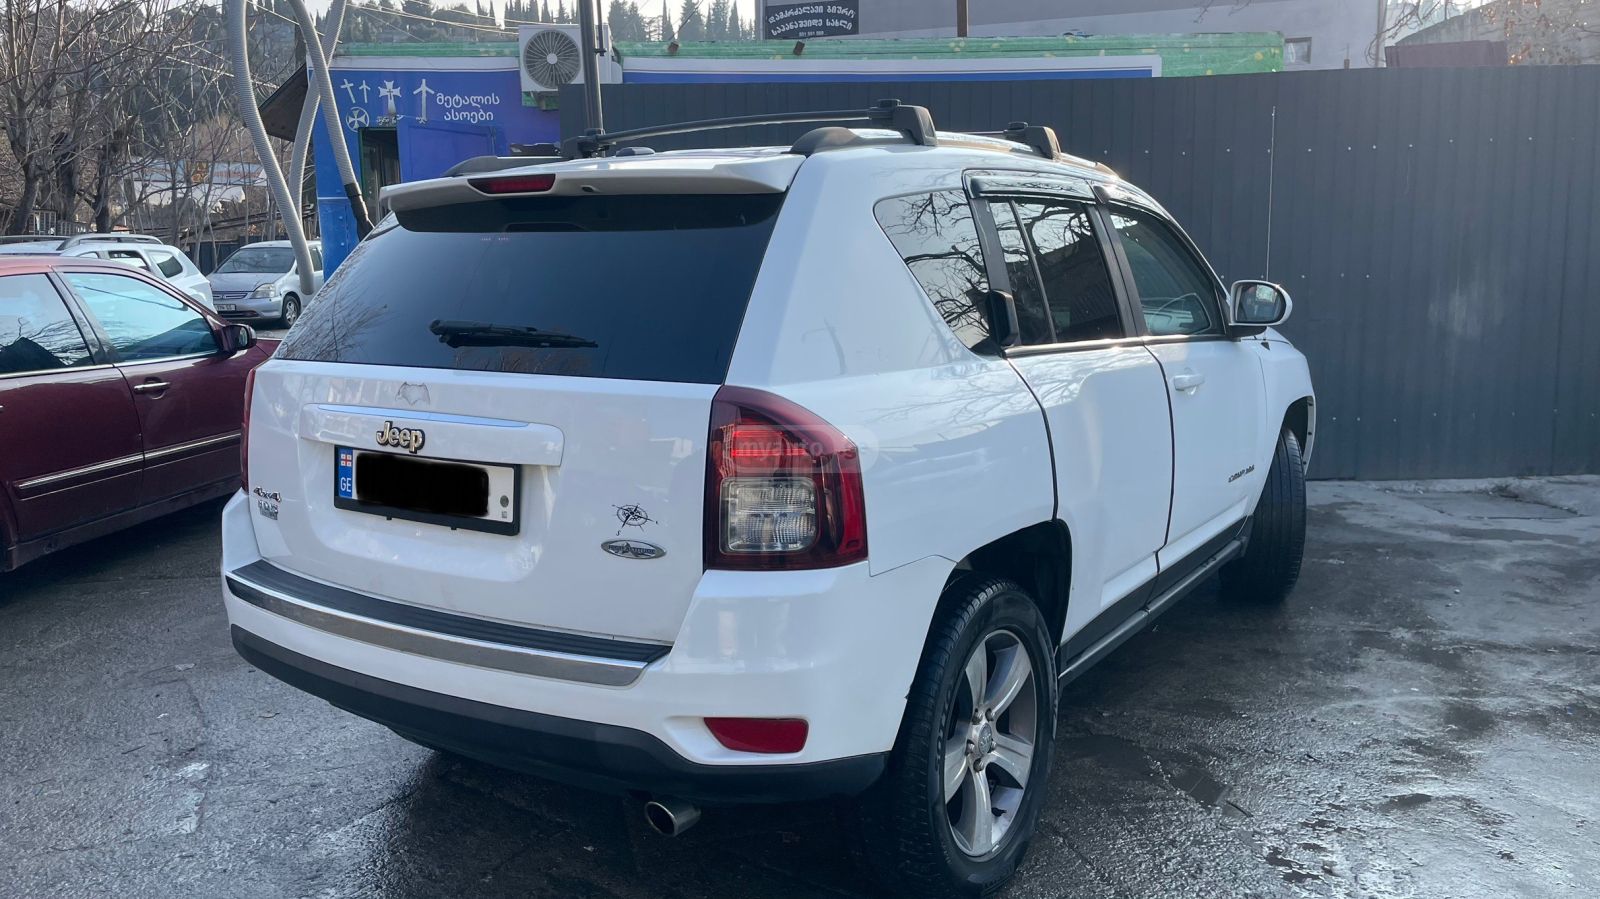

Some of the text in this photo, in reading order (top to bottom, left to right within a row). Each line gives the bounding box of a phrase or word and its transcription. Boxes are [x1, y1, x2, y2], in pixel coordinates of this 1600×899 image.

[436, 92, 500, 108] მეტალის
[444, 109, 494, 124] ასოები
[376, 421, 425, 453] Jeep
[340, 477, 352, 493] GE
